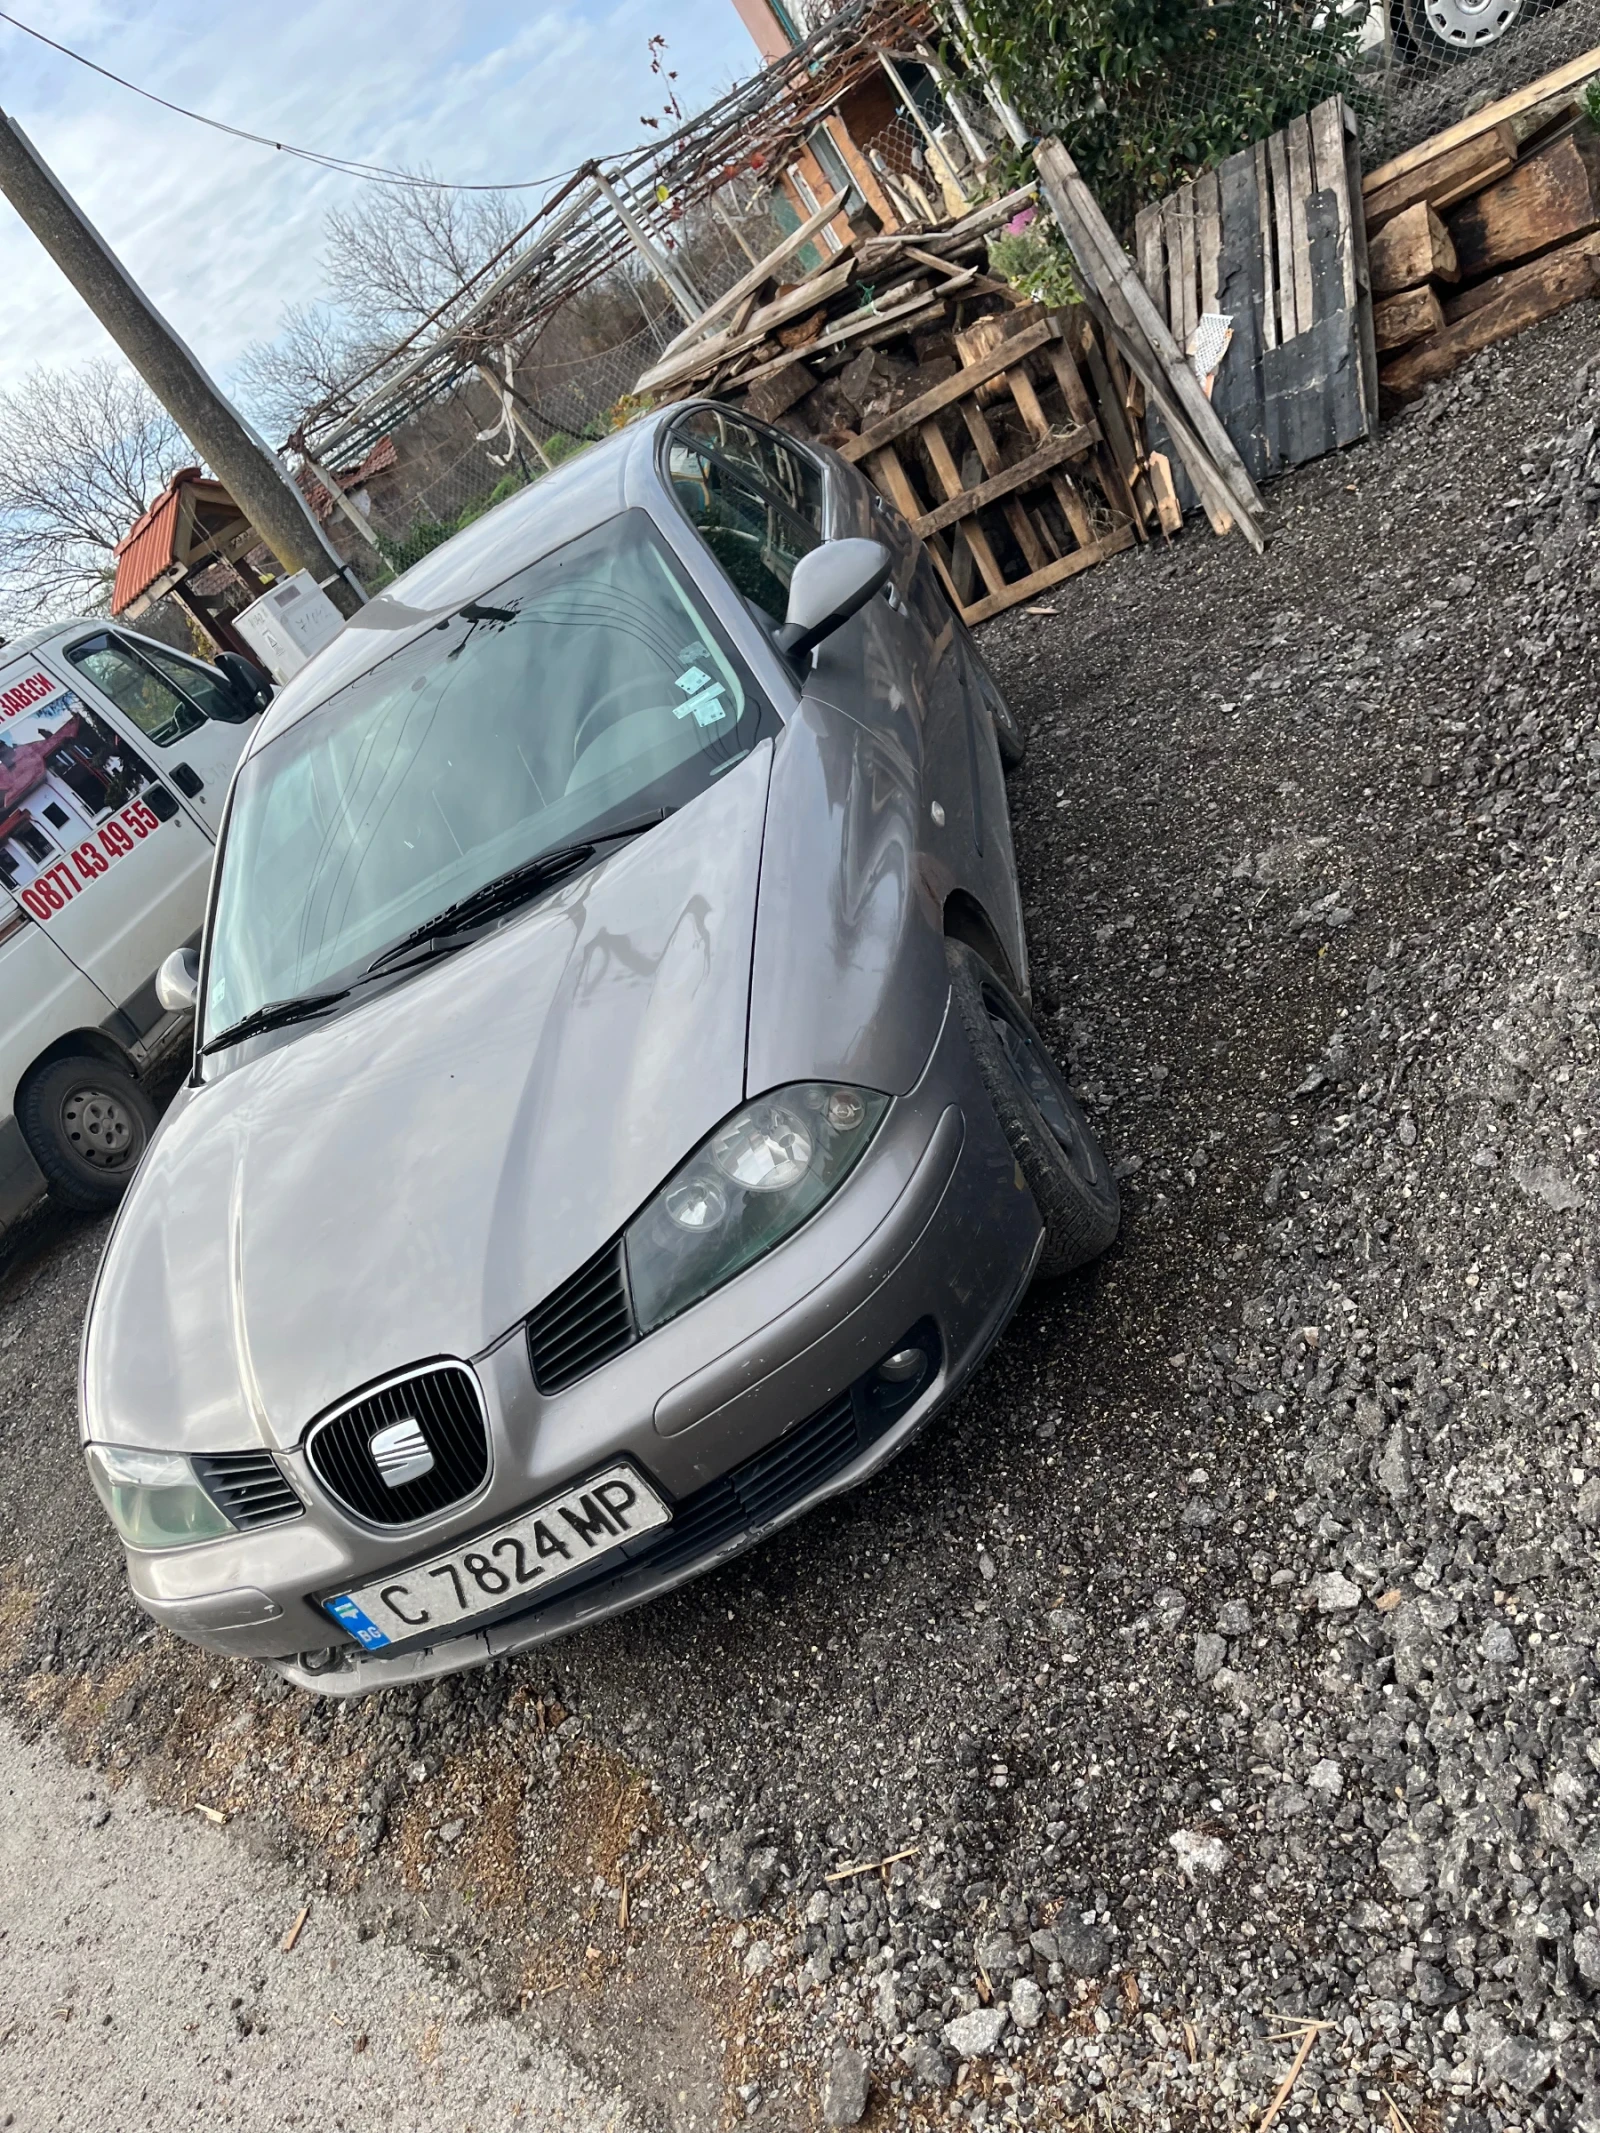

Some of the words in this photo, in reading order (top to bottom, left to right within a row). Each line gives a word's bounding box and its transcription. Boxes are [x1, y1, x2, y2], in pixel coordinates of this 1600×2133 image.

[21, 862, 82, 920] 0877
[71, 842, 109, 880] 43
[98, 821, 134, 857] 49
[120, 800, 159, 839] 55
[380, 1585, 429, 1625] C
[428, 1519, 572, 1609] 7824
[557, 1480, 637, 1548] MP
[357, 1626, 382, 1643] BG
